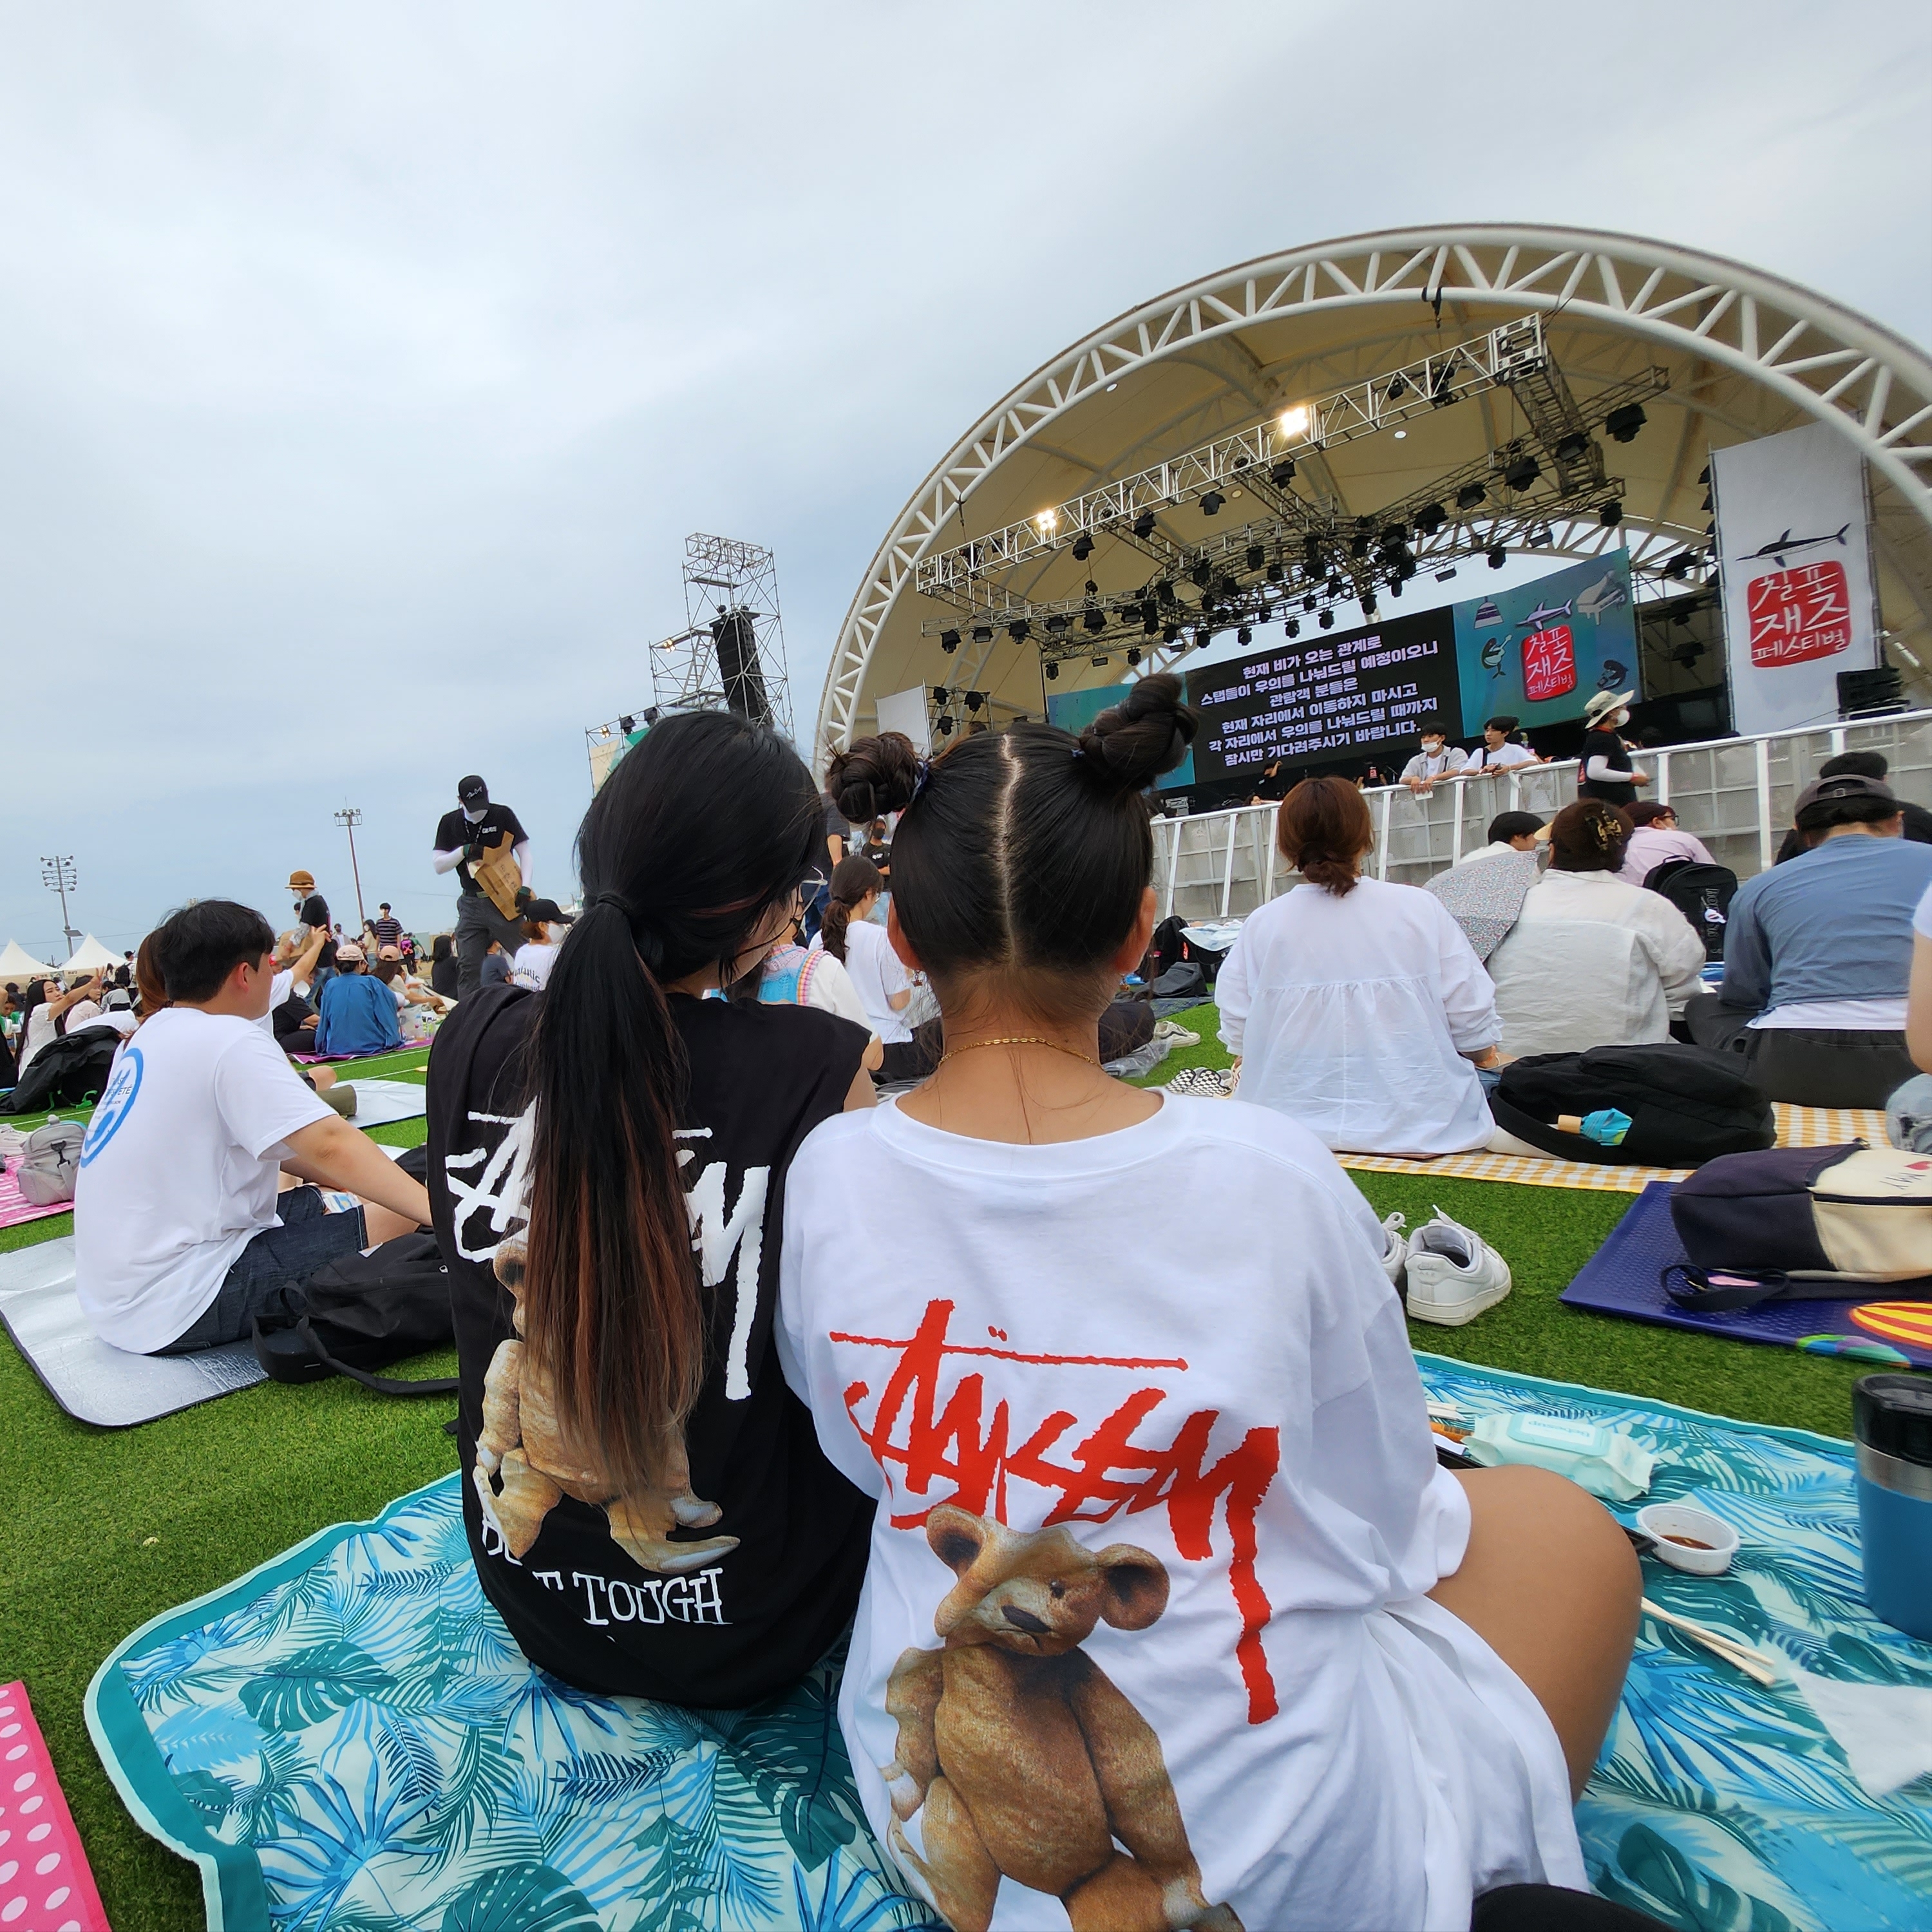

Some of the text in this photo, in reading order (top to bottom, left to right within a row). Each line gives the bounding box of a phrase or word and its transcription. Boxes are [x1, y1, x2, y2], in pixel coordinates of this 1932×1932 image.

[1751, 564, 1840, 612] 칠포
[1750, 592, 1850, 644] 재즈
[1243, 635, 1383, 680] 현재 비가 오는 관계로
[1526, 627, 1568, 661] 칠포
[1526, 647, 1574, 683] 재즈
[1751, 629, 1848, 662] 페스티벌
[1200, 640, 1439, 706] 스탭들이 우의를 나눠드릴 예정이오니
[1269, 677, 1359, 708] 관람객 분들은
[1528, 673, 1573, 696] 페스티벌
[1209, 697, 1438, 752] 각 자리에서 우의를 나눠드릴 때까지
[1222, 683, 1419, 735] 현재 자리에서 이동하지 마시고
[1224, 720, 1422, 768] 잠시만 기다려주시기 바랍니다.
[572, 1567, 734, 1627] TOUGH
